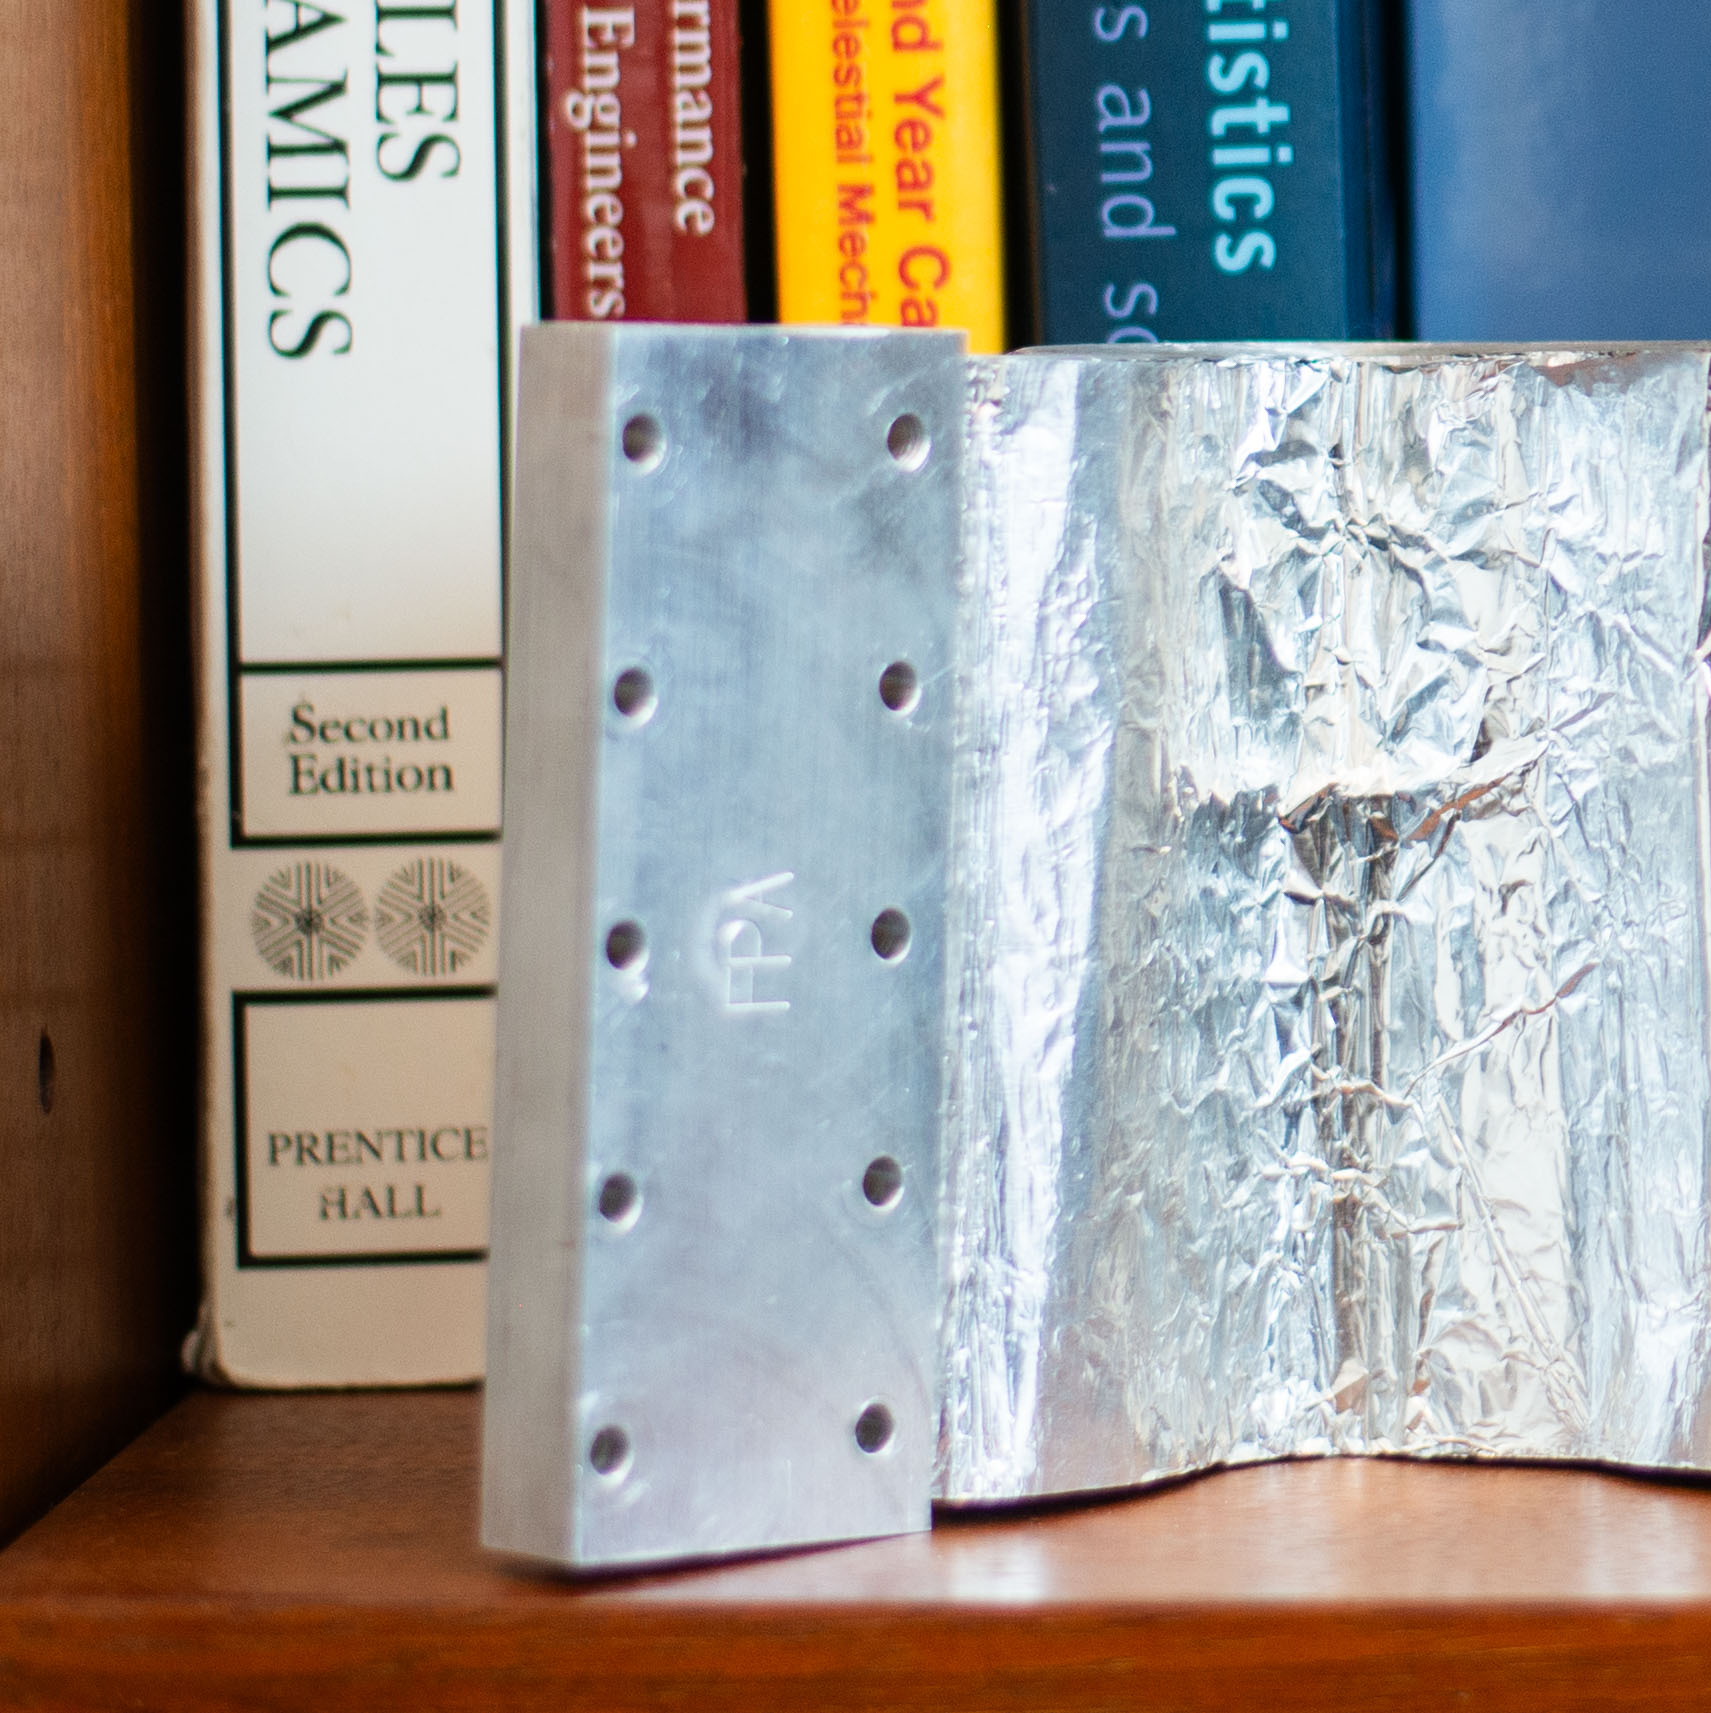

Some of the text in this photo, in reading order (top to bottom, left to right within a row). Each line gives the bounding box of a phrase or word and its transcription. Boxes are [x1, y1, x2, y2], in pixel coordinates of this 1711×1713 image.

[566, 7, 635, 318] Engineers
[888, 76, 945, 230] Year
[1093, 83, 1177, 242] and
[837, 184, 878, 325] Mech
[284, 700, 451, 746] Second
[289, 755, 453, 798] Edition
[267, 1128, 488, 1168] PRENTICE
[318, 1186, 441, 1221] HALL
